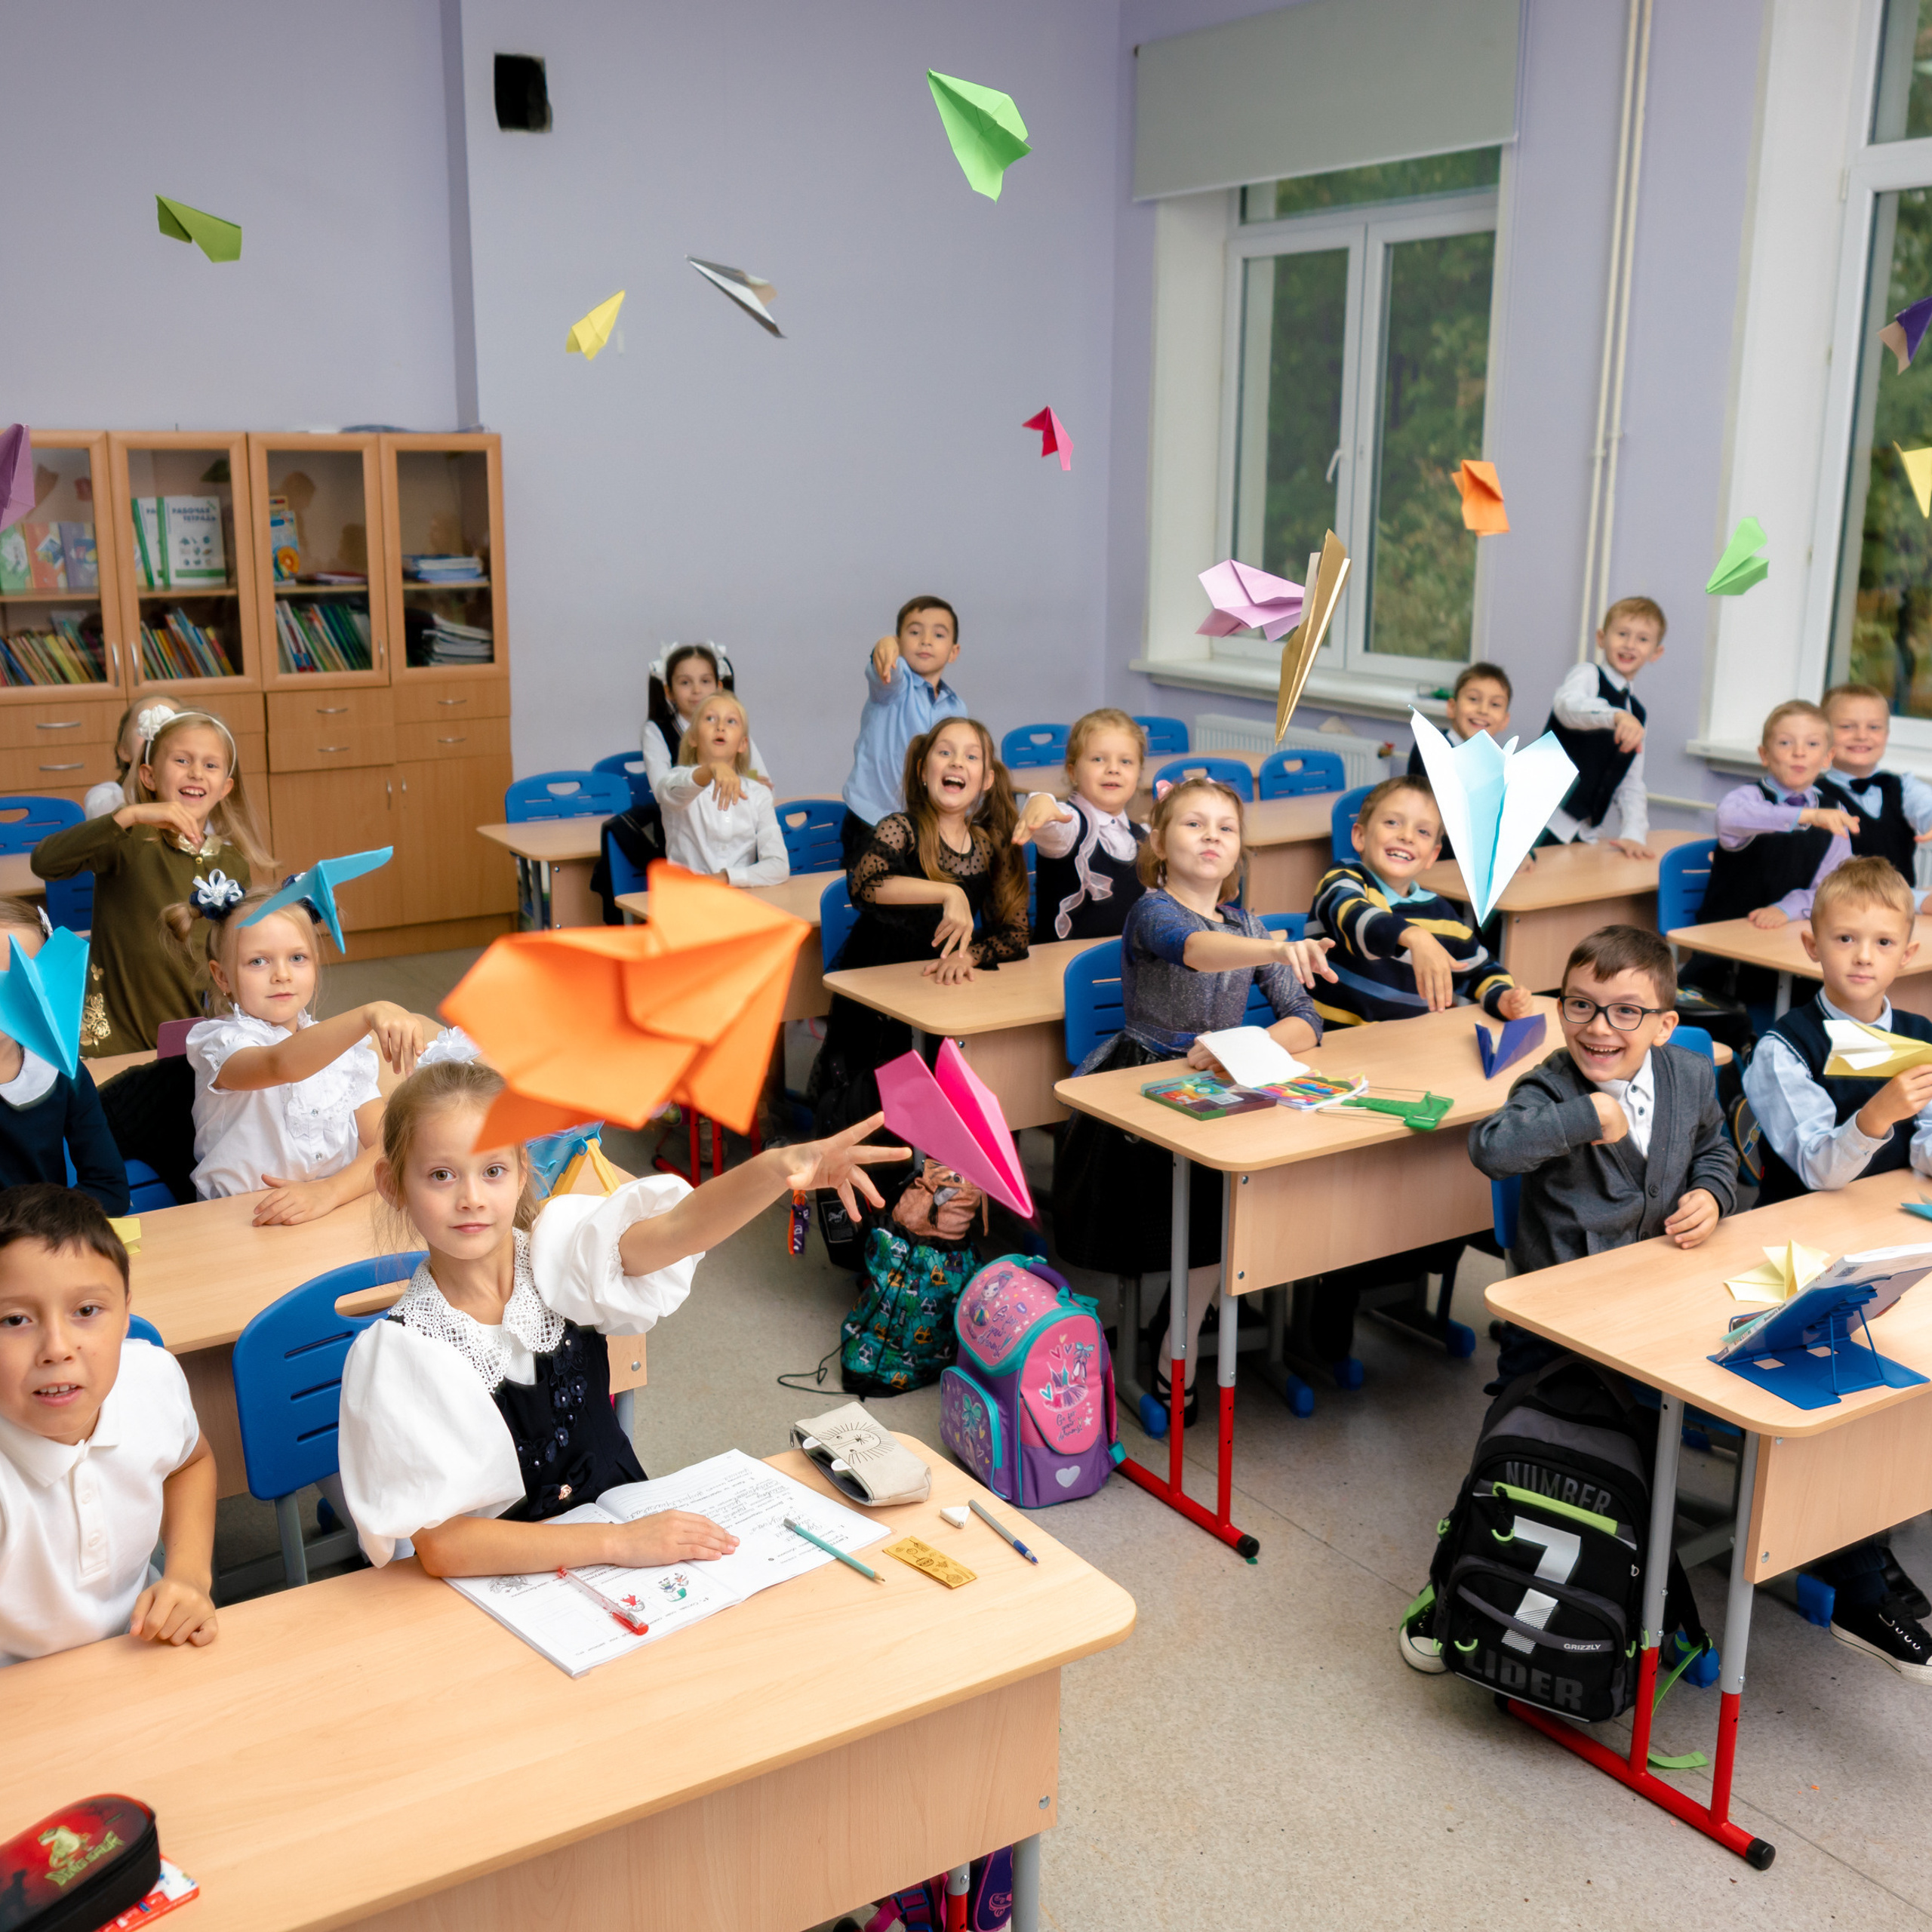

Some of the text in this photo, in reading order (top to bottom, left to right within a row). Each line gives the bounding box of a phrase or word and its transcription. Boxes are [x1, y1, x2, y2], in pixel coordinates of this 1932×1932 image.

[992, 1304, 1008, 1322] Go
[1057, 1414, 1066, 1426] Go
[1506, 1461, 1612, 1515] NUMBER
[1501, 1515, 1582, 1654] 7
[1463, 1649, 1583, 1711] LIDER
